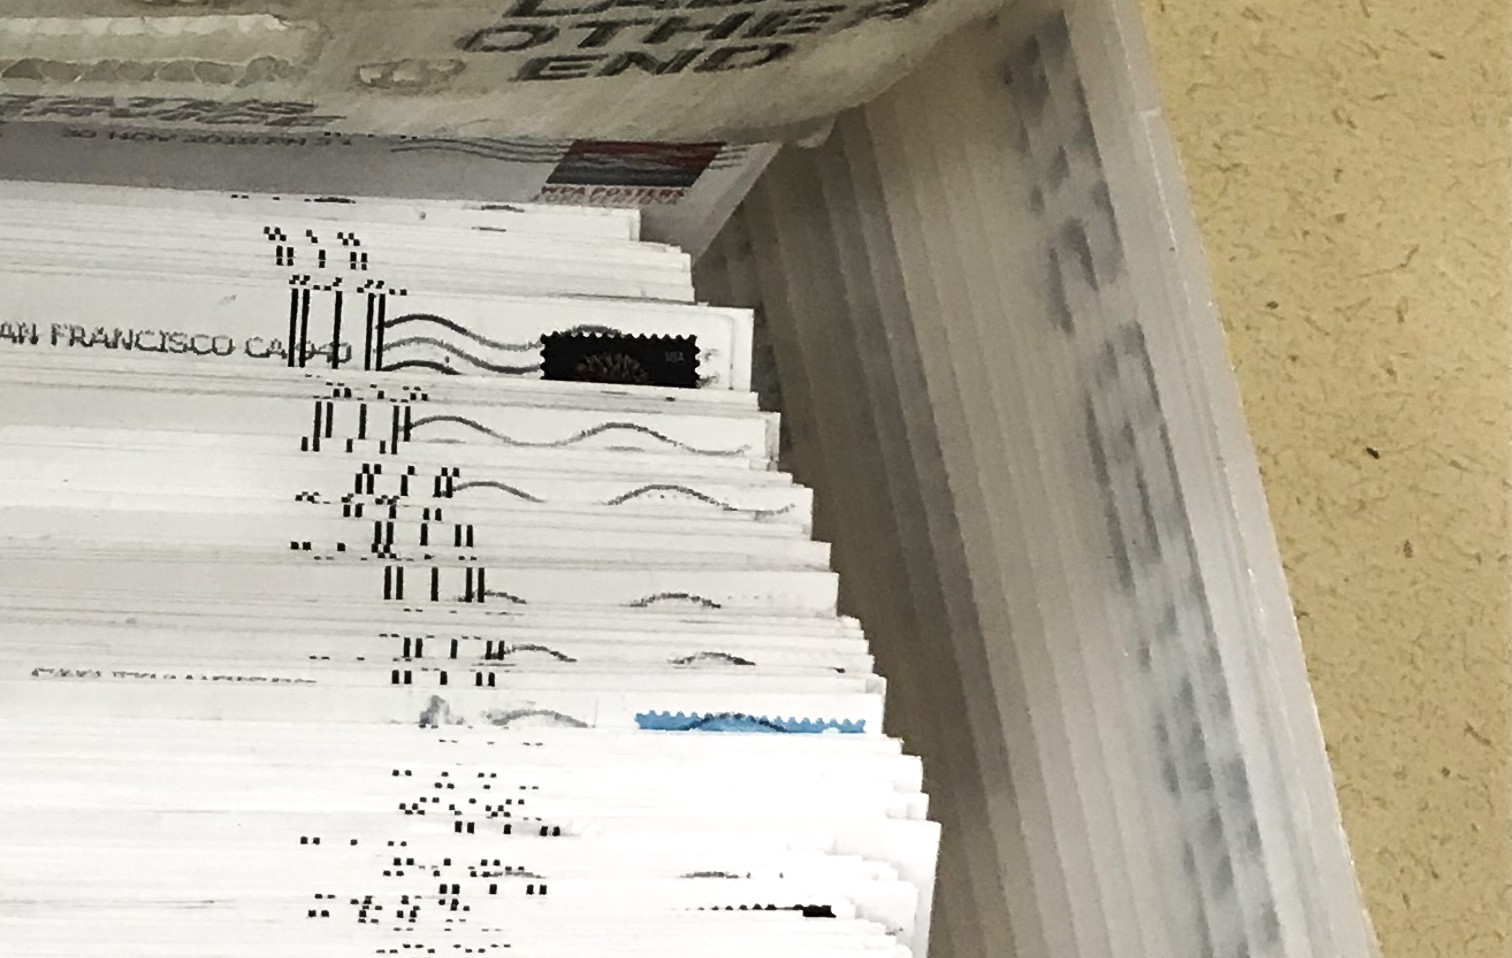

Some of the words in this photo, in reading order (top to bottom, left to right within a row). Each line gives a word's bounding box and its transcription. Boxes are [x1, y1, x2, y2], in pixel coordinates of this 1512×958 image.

[508, 43, 796, 82] END
[50, 322, 234, 356] FRANCISCO
[243, 335, 288, 359] CA
